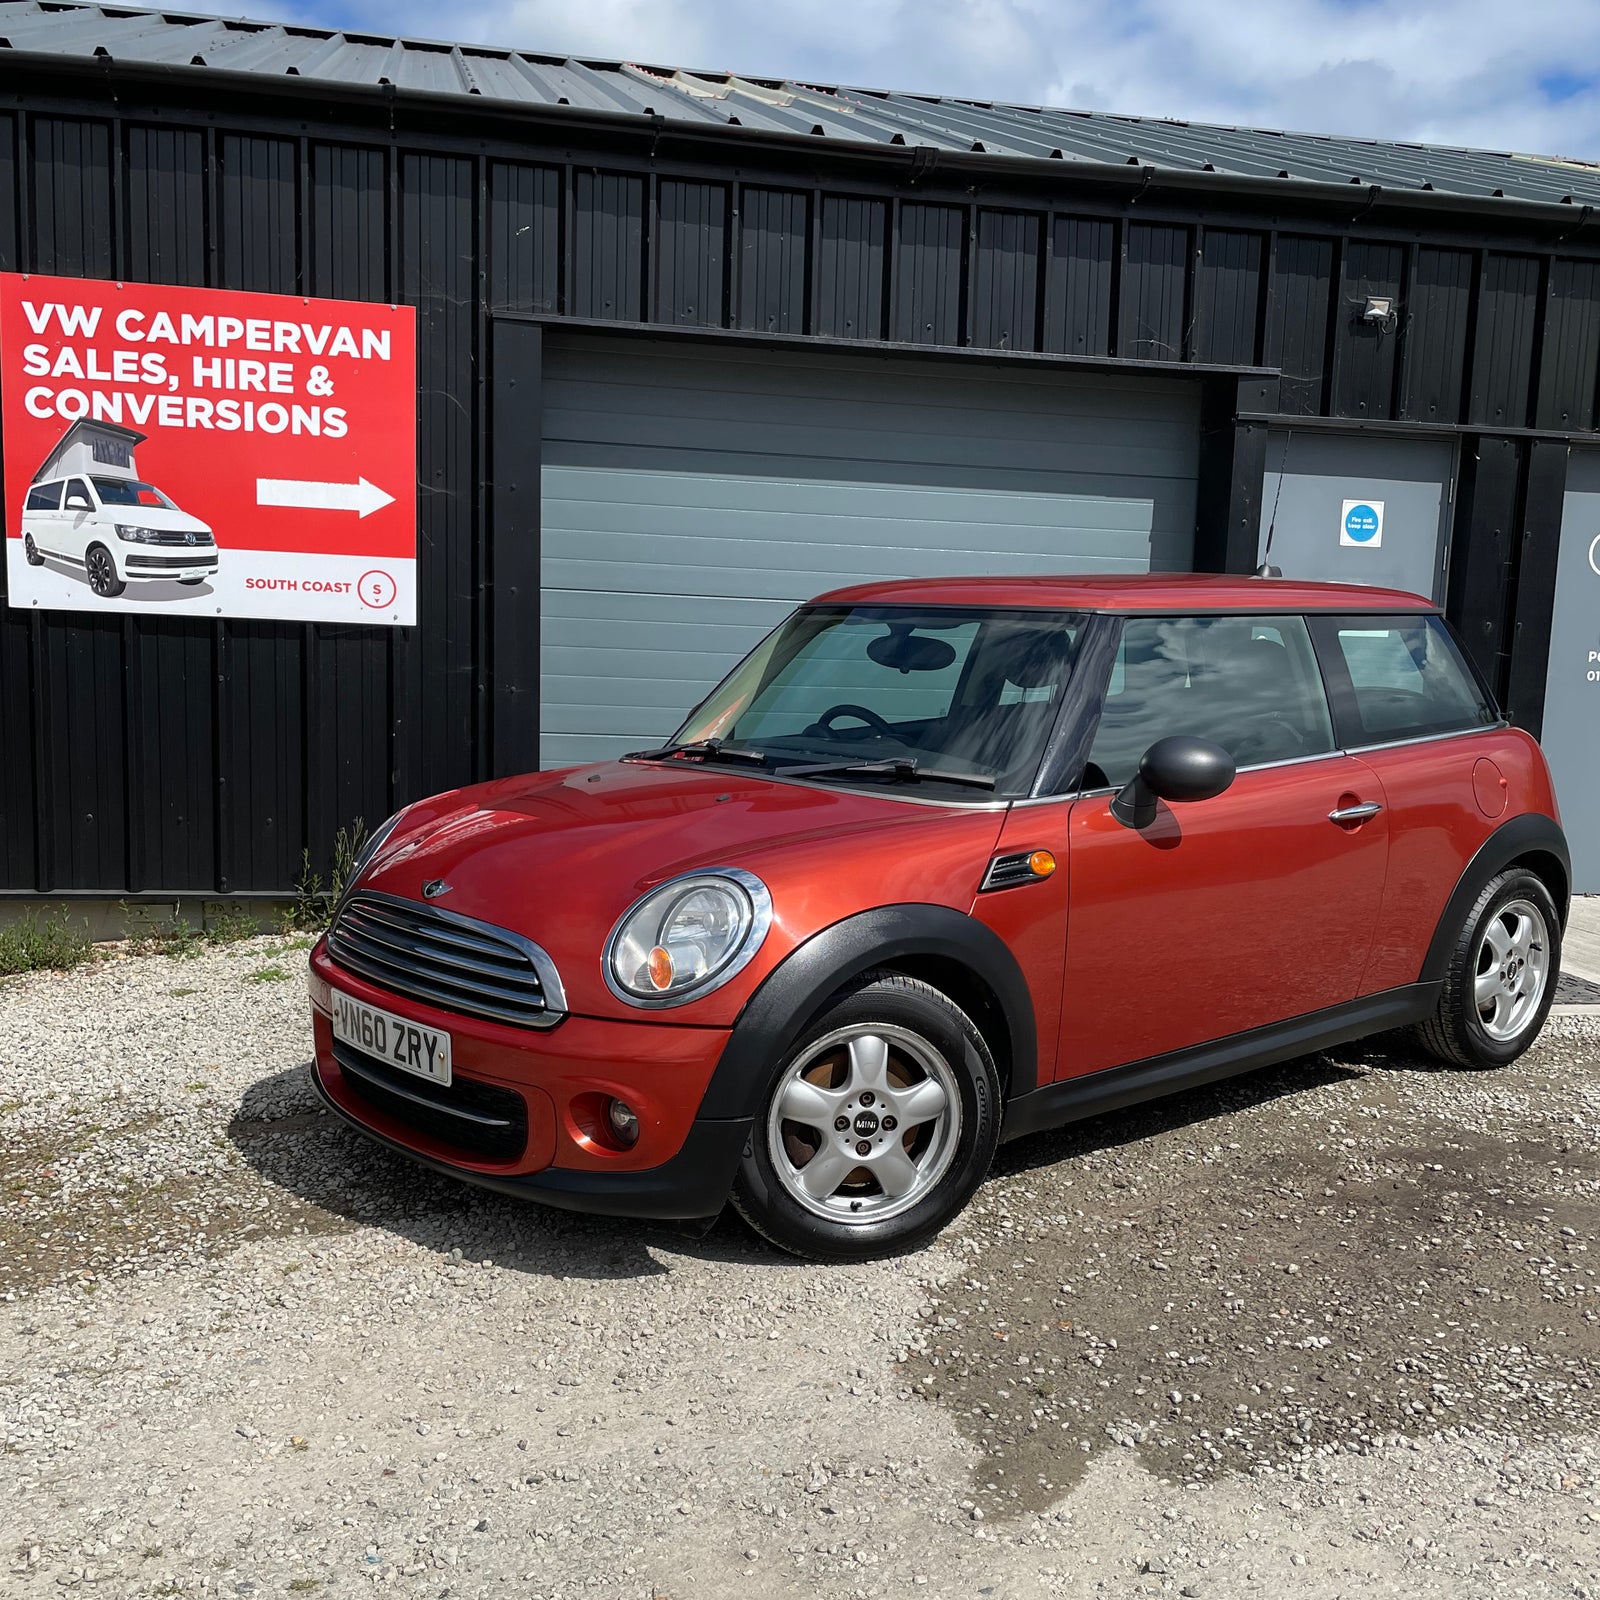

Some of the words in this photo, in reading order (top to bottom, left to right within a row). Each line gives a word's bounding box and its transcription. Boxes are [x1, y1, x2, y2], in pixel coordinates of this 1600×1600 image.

[21, 300, 103, 338] VW
[115, 309, 391, 361] CAMPERVAN
[22, 343, 180, 392] SALES,
[192, 355, 294, 394] HIRE
[306, 365, 335, 397] &
[24, 386, 348, 438] CONVERSIONS
[245, 578, 298, 591] SOUTH
[301, 580, 352, 593] COAST
[339, 997, 386, 1054] VN60
[392, 1021, 438, 1073] ZRY
[856, 1119, 877, 1129] MINI
